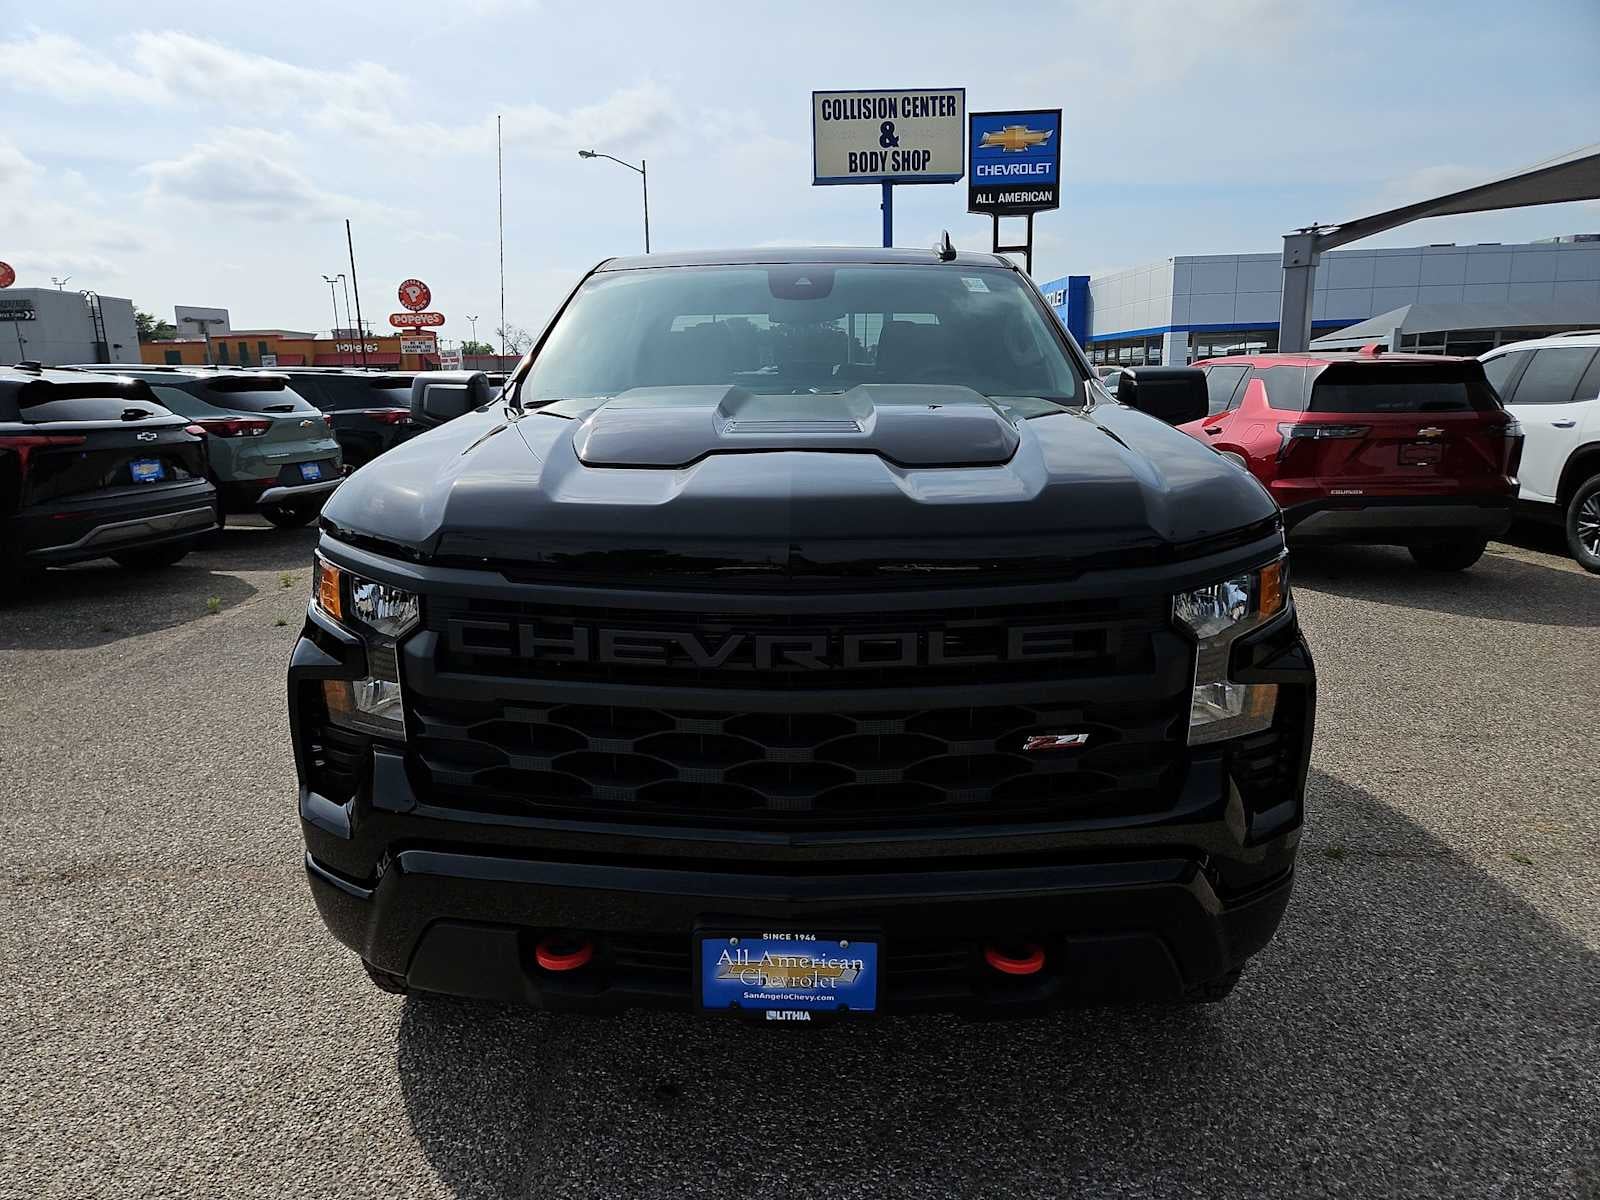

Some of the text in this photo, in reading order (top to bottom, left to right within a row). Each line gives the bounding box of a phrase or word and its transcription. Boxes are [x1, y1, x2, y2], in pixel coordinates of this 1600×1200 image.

[822, 95, 957, 121] COLLISION CENTER
[879, 121, 900, 148] &
[848, 149, 931, 173] BODY SHOP
[976, 162, 1052, 177] CHEVROLET
[975, 190, 1053, 204] ALL AMERICAN
[447, 617, 1121, 671] CHEVROLET
[1023, 733, 1089, 750] Z71
[762, 933, 791, 941] SINCE
[716, 949, 865, 970] All American
[739, 968, 838, 989] Chevrolet
[743, 991, 835, 1002] SanAngeloChevy.com
[776, 1011, 811, 1021] LITHIA
